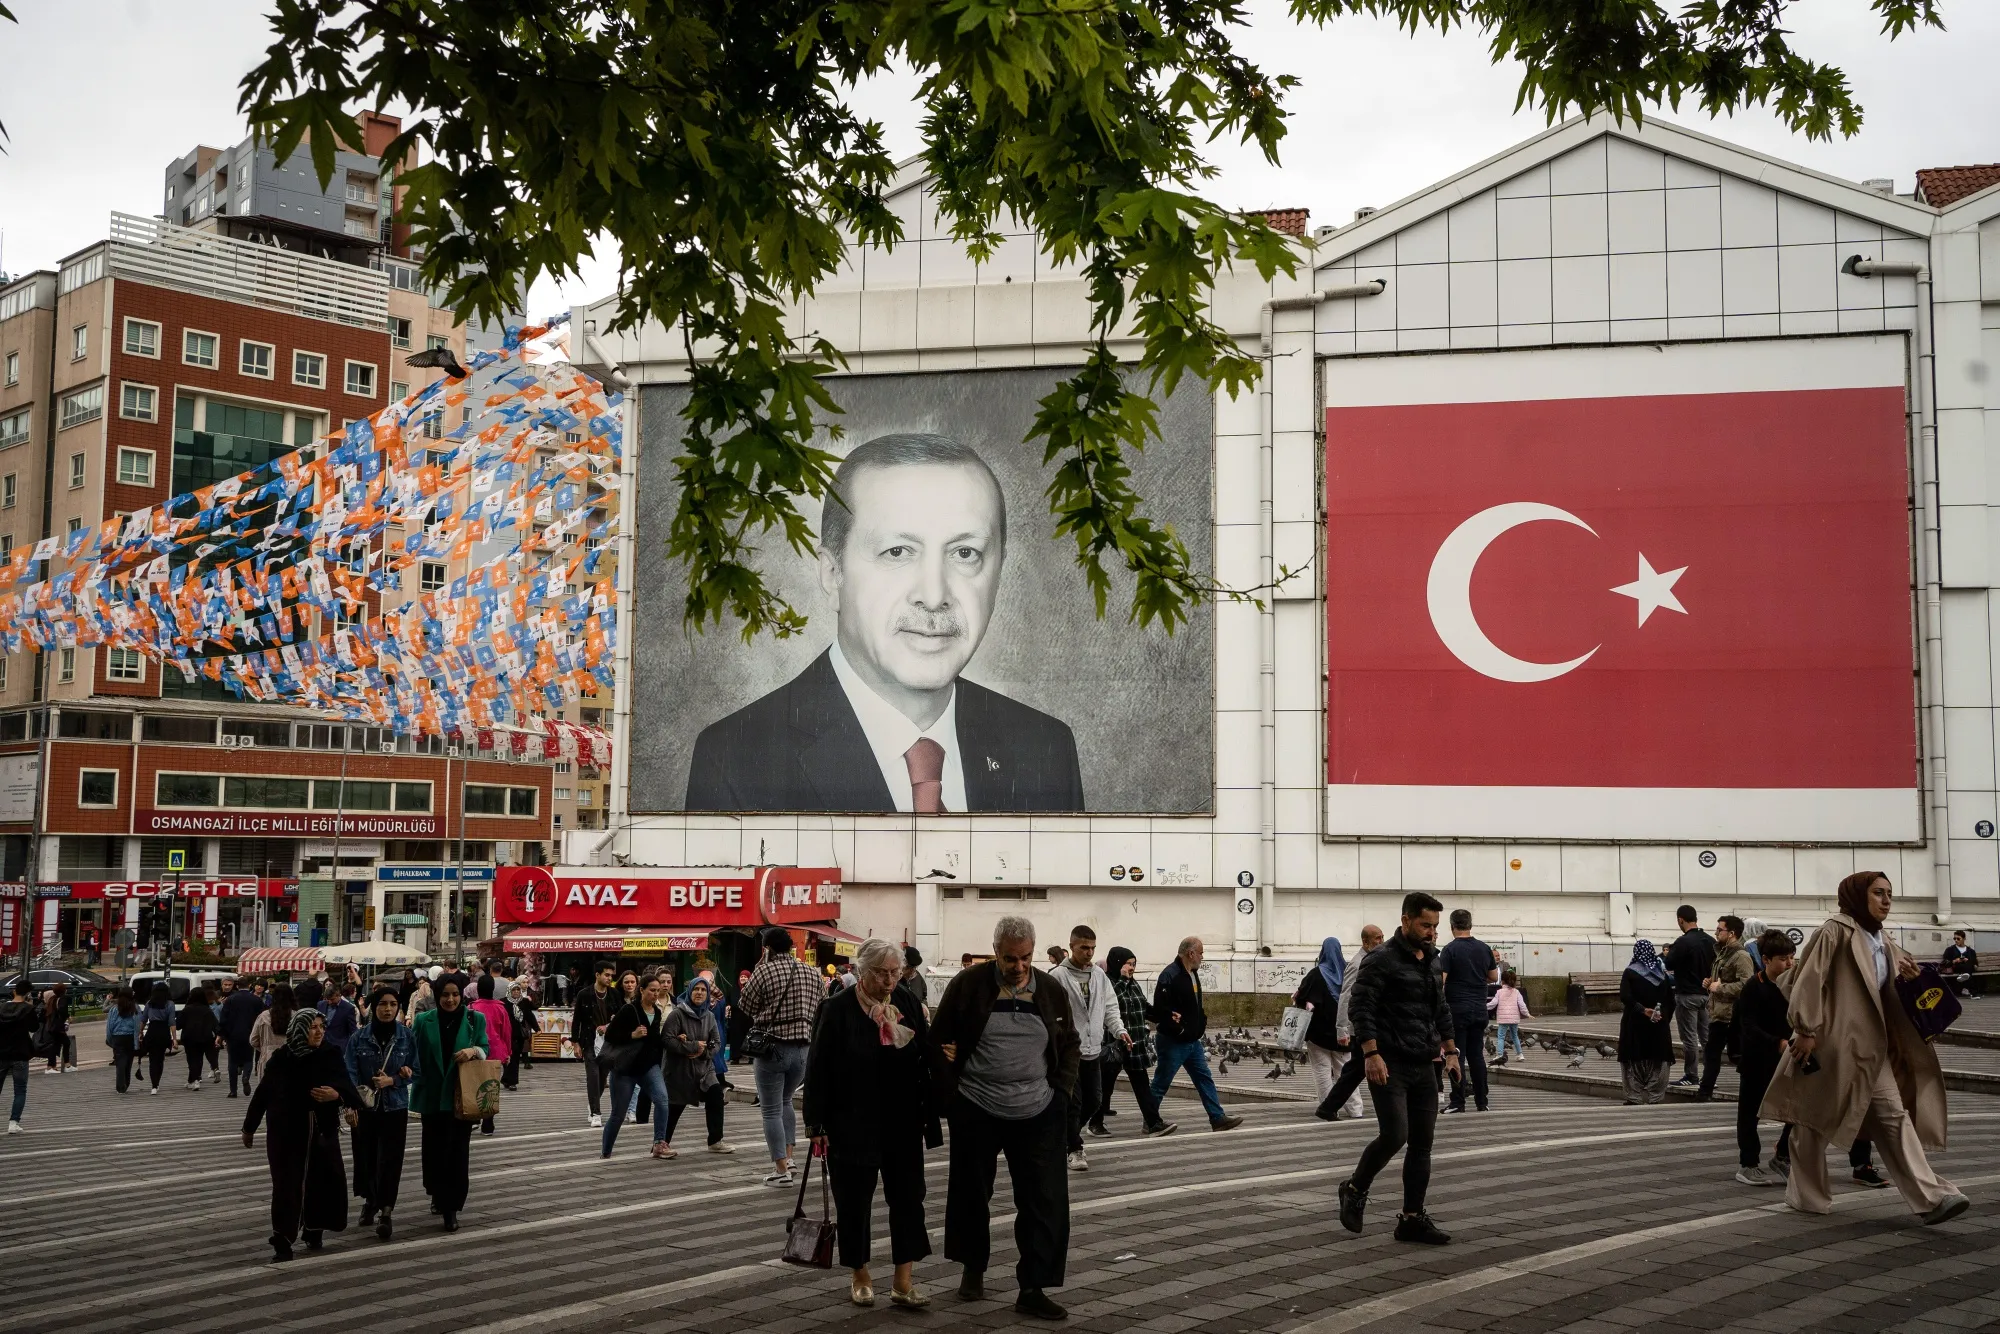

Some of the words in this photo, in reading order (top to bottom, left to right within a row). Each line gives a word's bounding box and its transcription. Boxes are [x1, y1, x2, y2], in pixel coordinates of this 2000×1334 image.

[151, 815, 234, 831] OSMANGAZİ
[238, 815, 268, 833] İLÇE
[272, 816, 308, 832] MİLLİ
[311, 817, 354, 832] EĞİTİM
[358, 818, 436, 834] MÜDÜRLÜĞÜ
[102, 883, 256, 897] ECZANE
[565, 884, 638, 907] AYAZ
[669, 880, 743, 908] BÜFE
[816, 880, 842, 904] BÜFE
[512, 941, 539, 949] BUKART
[540, 941, 564, 949] DOLUM
[564, 941, 574, 949] VE
[574, 940, 593, 951] SATIŞ
[594, 938, 624, 949] MERKEZİ
[1919, 988, 1940, 1008] gratis
